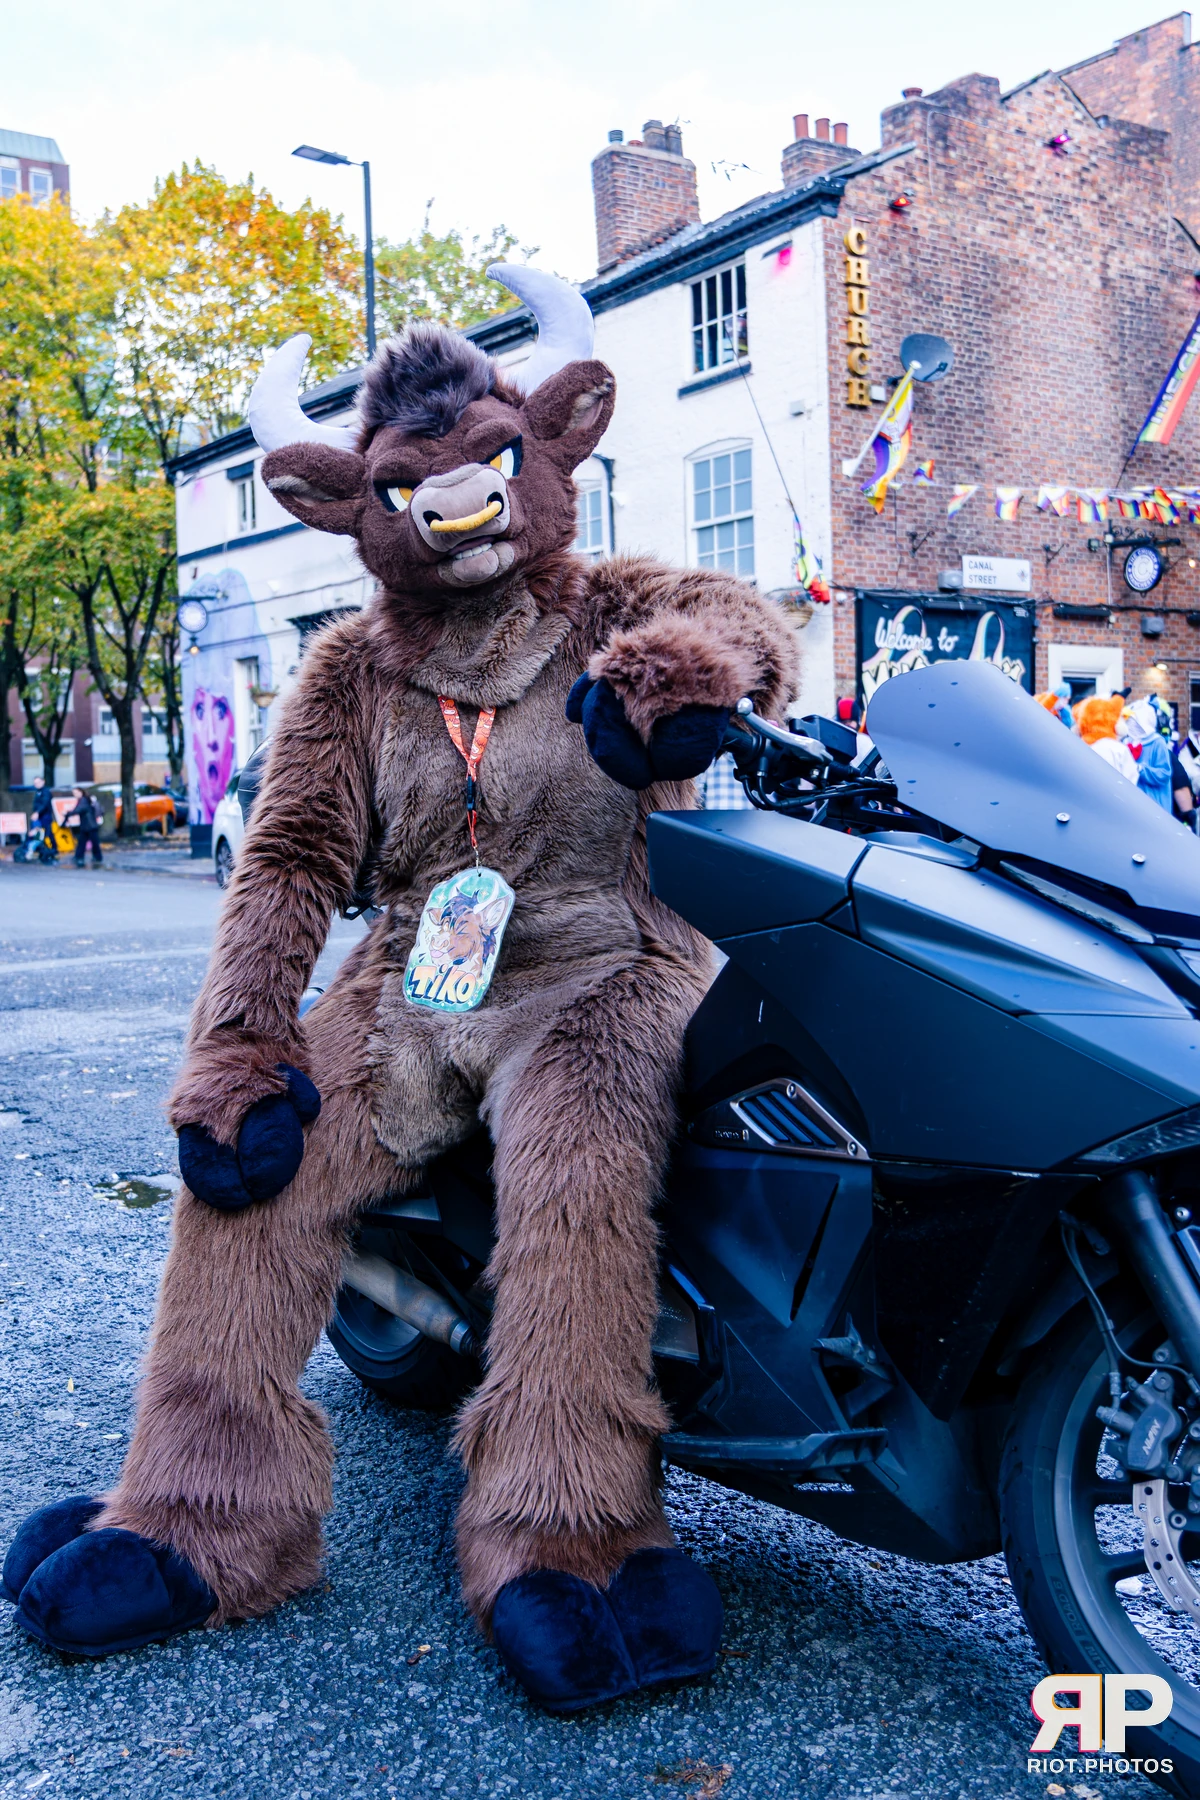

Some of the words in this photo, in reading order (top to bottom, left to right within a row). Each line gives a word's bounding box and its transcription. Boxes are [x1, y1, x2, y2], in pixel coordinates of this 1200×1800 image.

[844, 227, 871, 407] CHURCH
[968, 560, 994, 571] CANAL
[968, 574, 997, 585] STREET
[875, 617, 933, 651] Welcome
[937, 626, 959, 652] to
